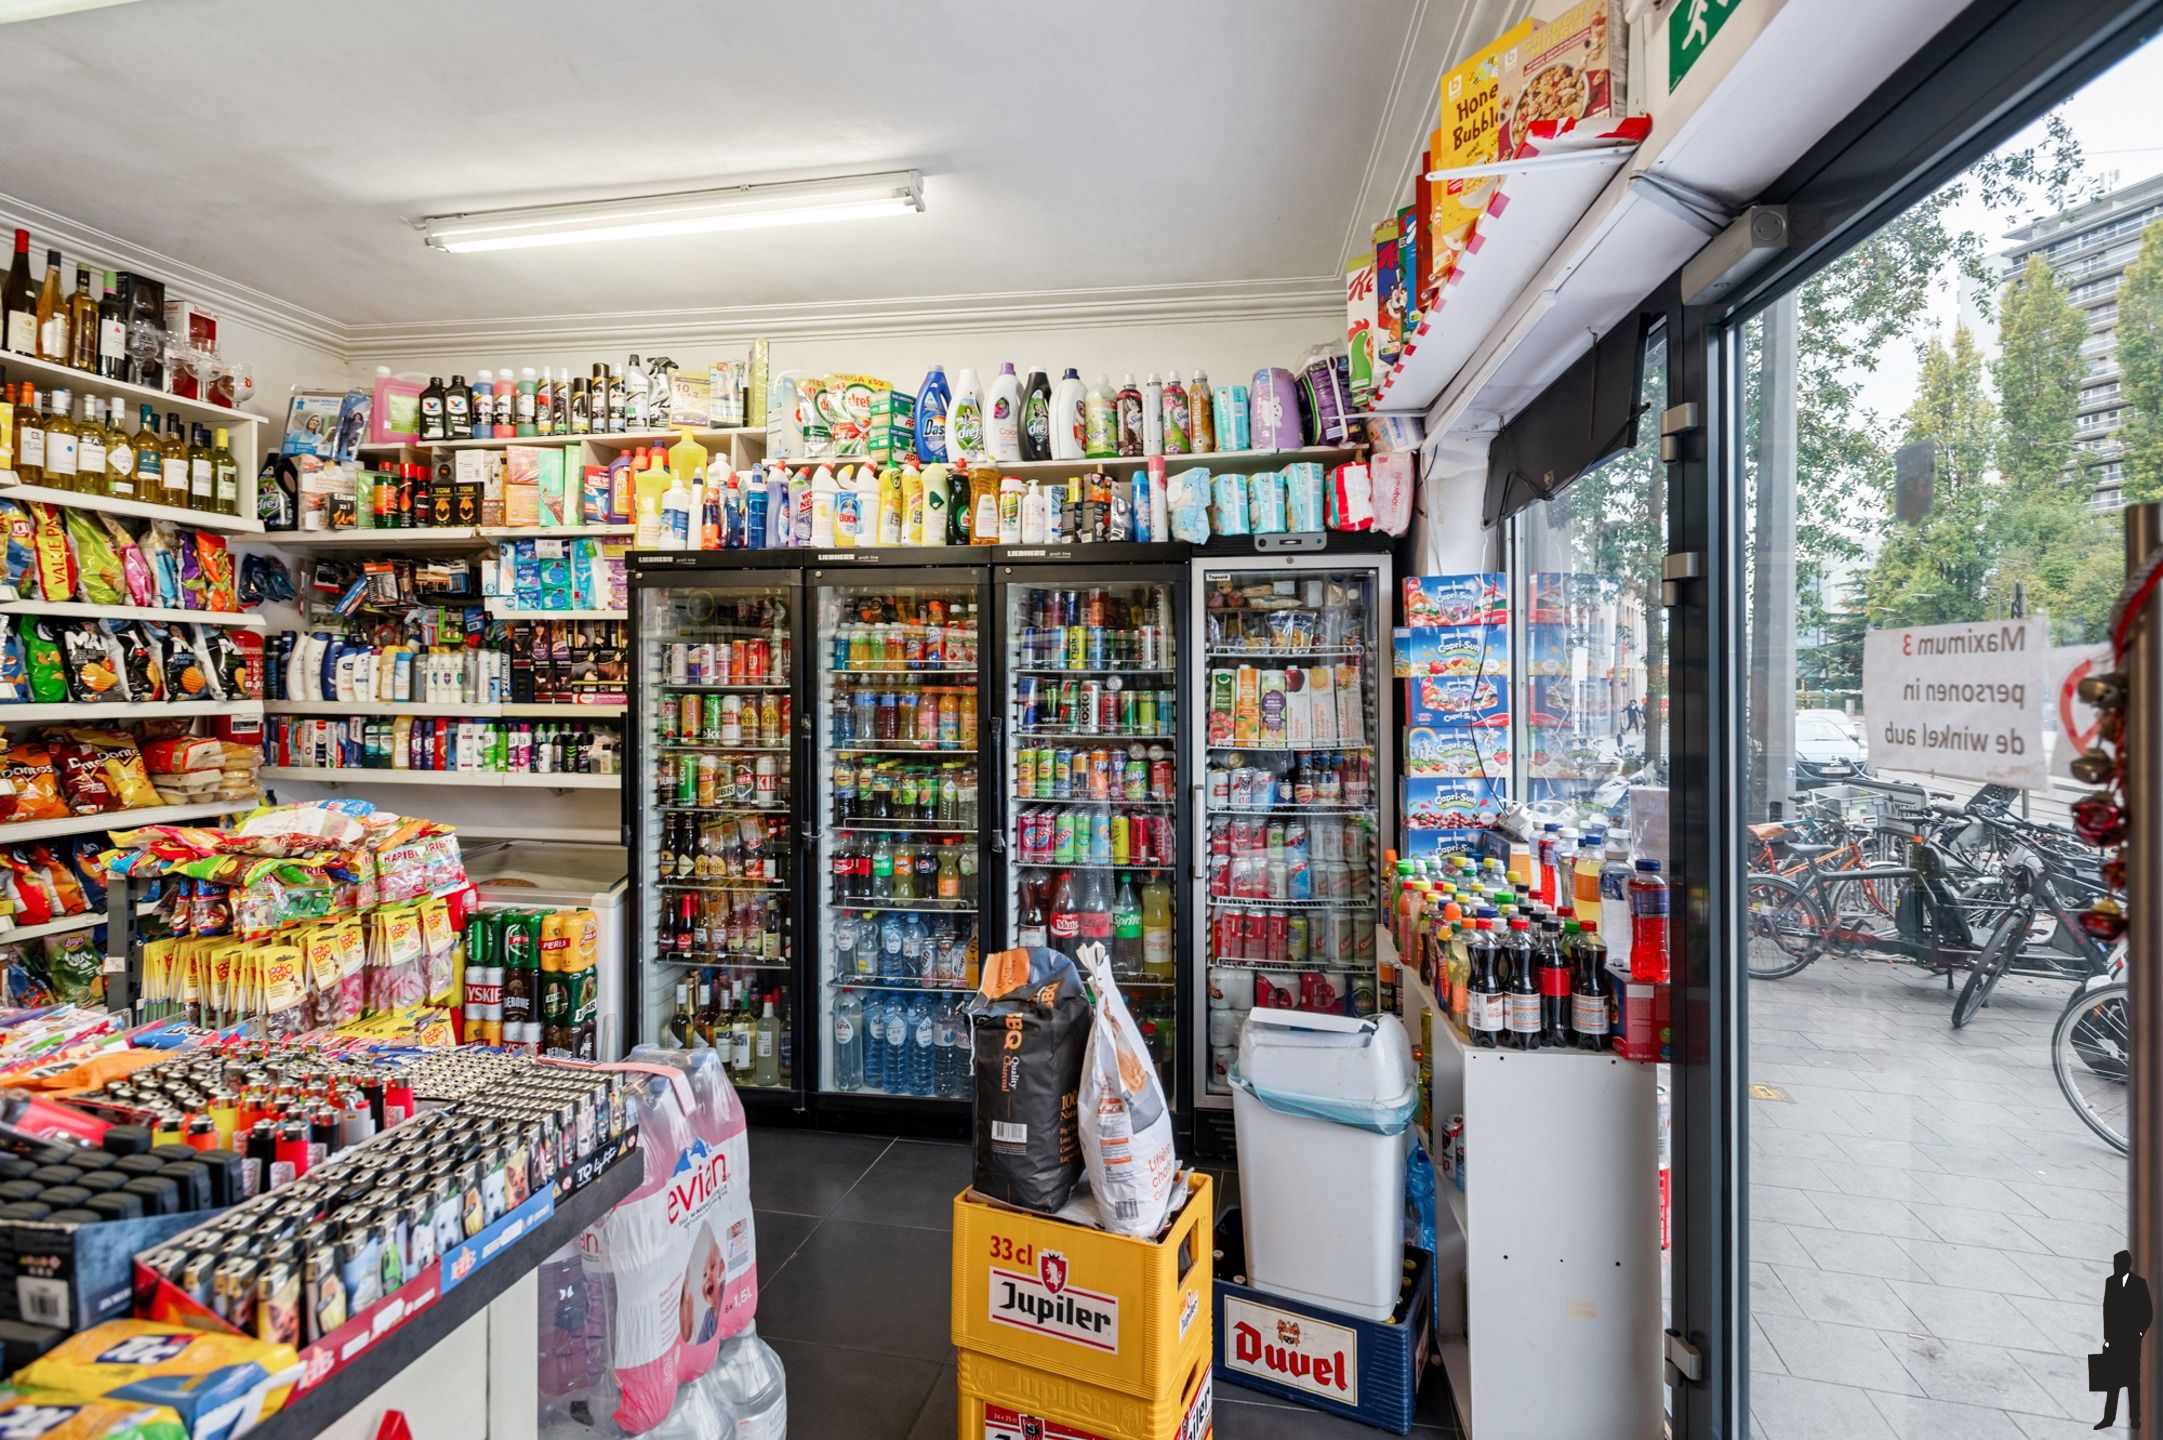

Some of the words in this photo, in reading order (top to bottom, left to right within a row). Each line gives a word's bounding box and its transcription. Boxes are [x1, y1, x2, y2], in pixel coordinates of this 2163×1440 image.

[1437, 592, 1474, 603] Capri-Sun
[1435, 793, 1477, 804] Capri-Sun
[1114, 914, 1142, 927] Sprite
[1001, 1054, 1010, 1093] Charcoal
[1009, 1056, 1020, 1090] Quality
[668, 1153, 727, 1225] evian
[990, 1235, 1013, 1261] 33
[1016, 1243, 1033, 1266] cl
[998, 1281, 1112, 1334] Jupiler
[1233, 1320, 1348, 1392] Duvel
